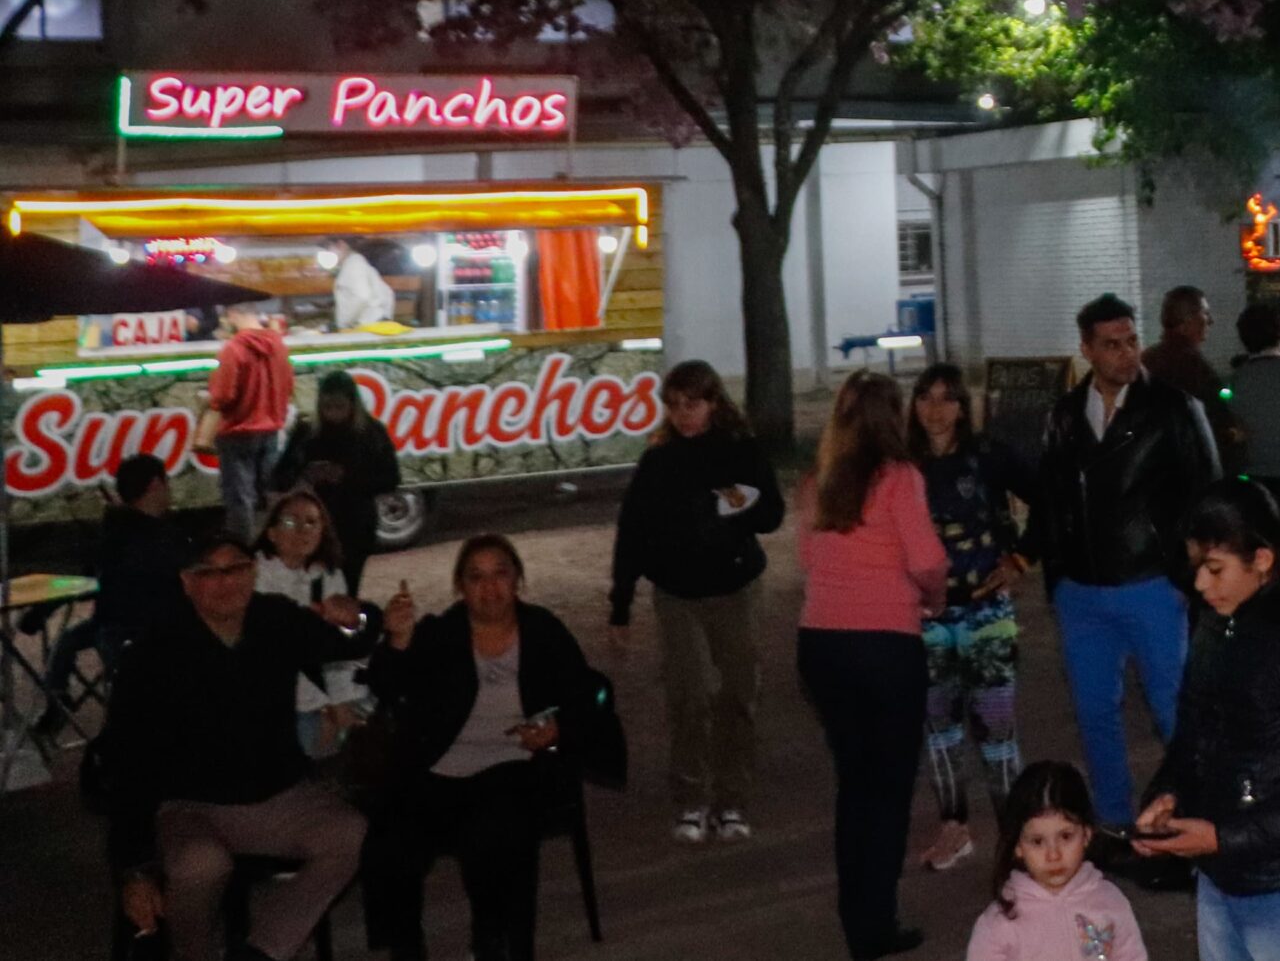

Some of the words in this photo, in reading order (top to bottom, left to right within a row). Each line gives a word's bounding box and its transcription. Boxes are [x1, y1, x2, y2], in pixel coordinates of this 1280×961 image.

[145, 75, 304, 129] Super
[332, 75, 567, 130] Panchos
[112, 318, 183, 346] CAJA
